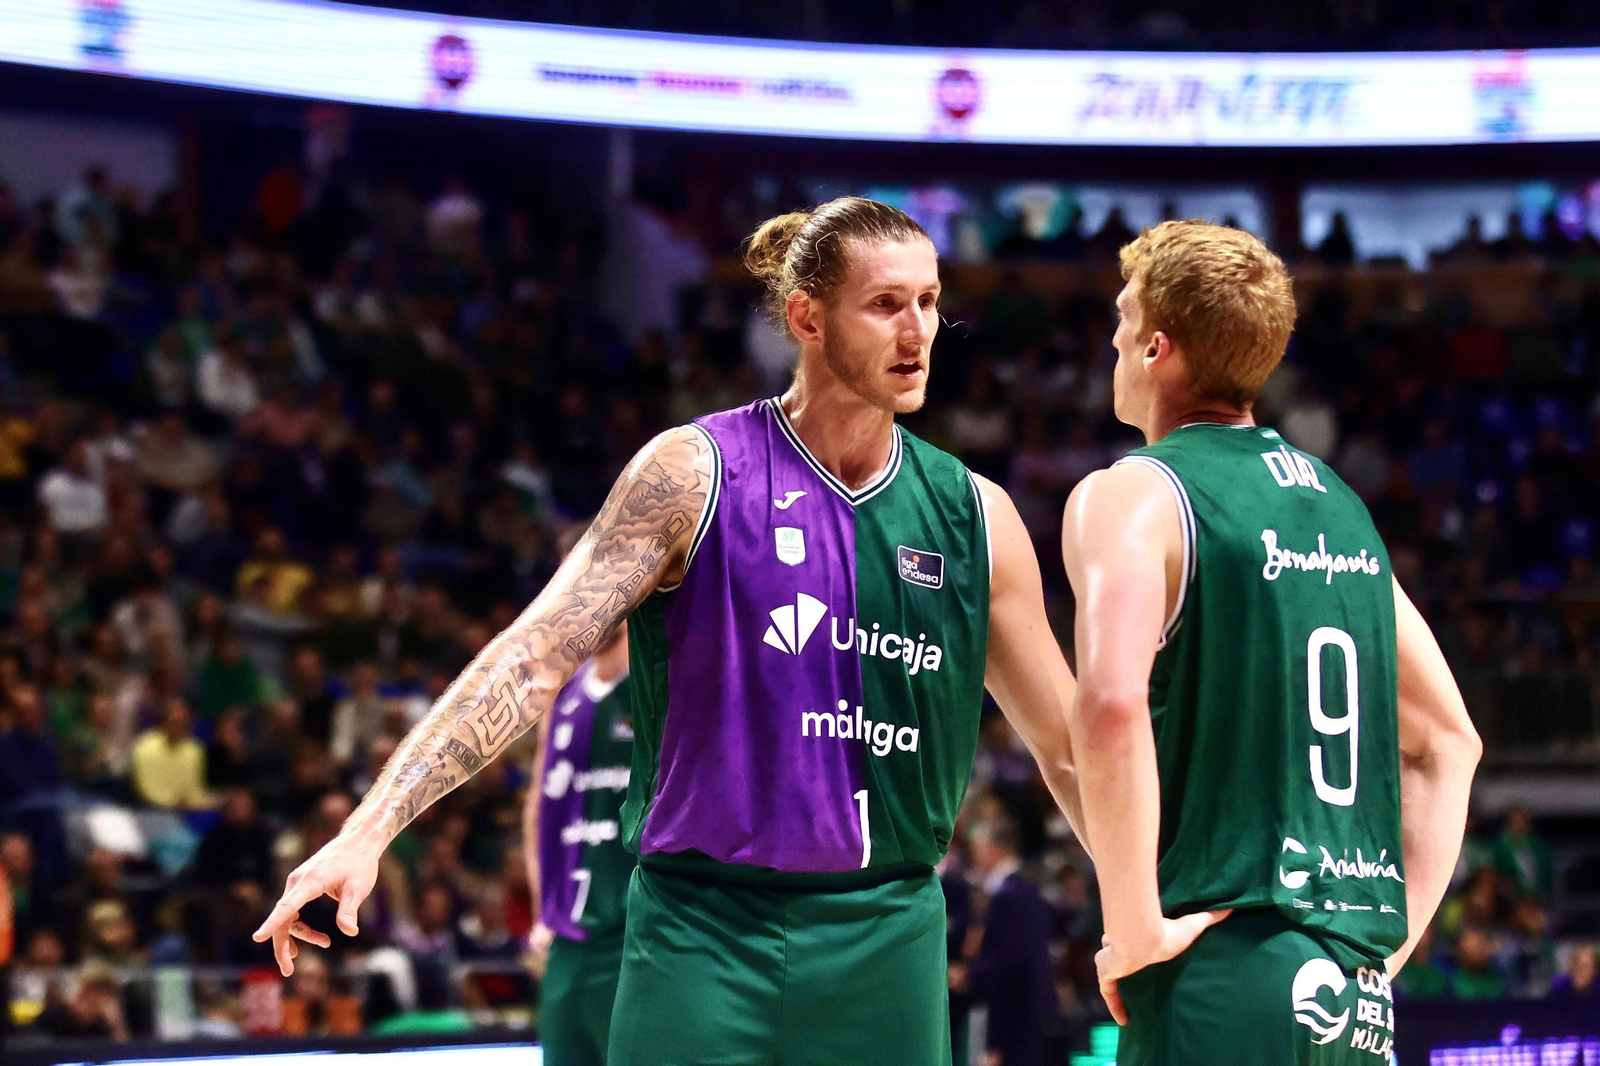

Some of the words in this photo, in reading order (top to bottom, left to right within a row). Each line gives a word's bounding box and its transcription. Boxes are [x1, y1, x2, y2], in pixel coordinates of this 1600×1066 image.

[567, 510, 694, 661] OHANA
[901, 556, 918, 570] liga
[902, 567, 939, 584] endesa
[831, 616, 943, 675] Unicaja
[1307, 626, 1359, 807] 9
[853, 789, 871, 869] 1
[1356, 966, 1393, 1003] COS
[1356, 997, 1386, 1027] DEL
[1386, 1007, 1394, 1032] S
